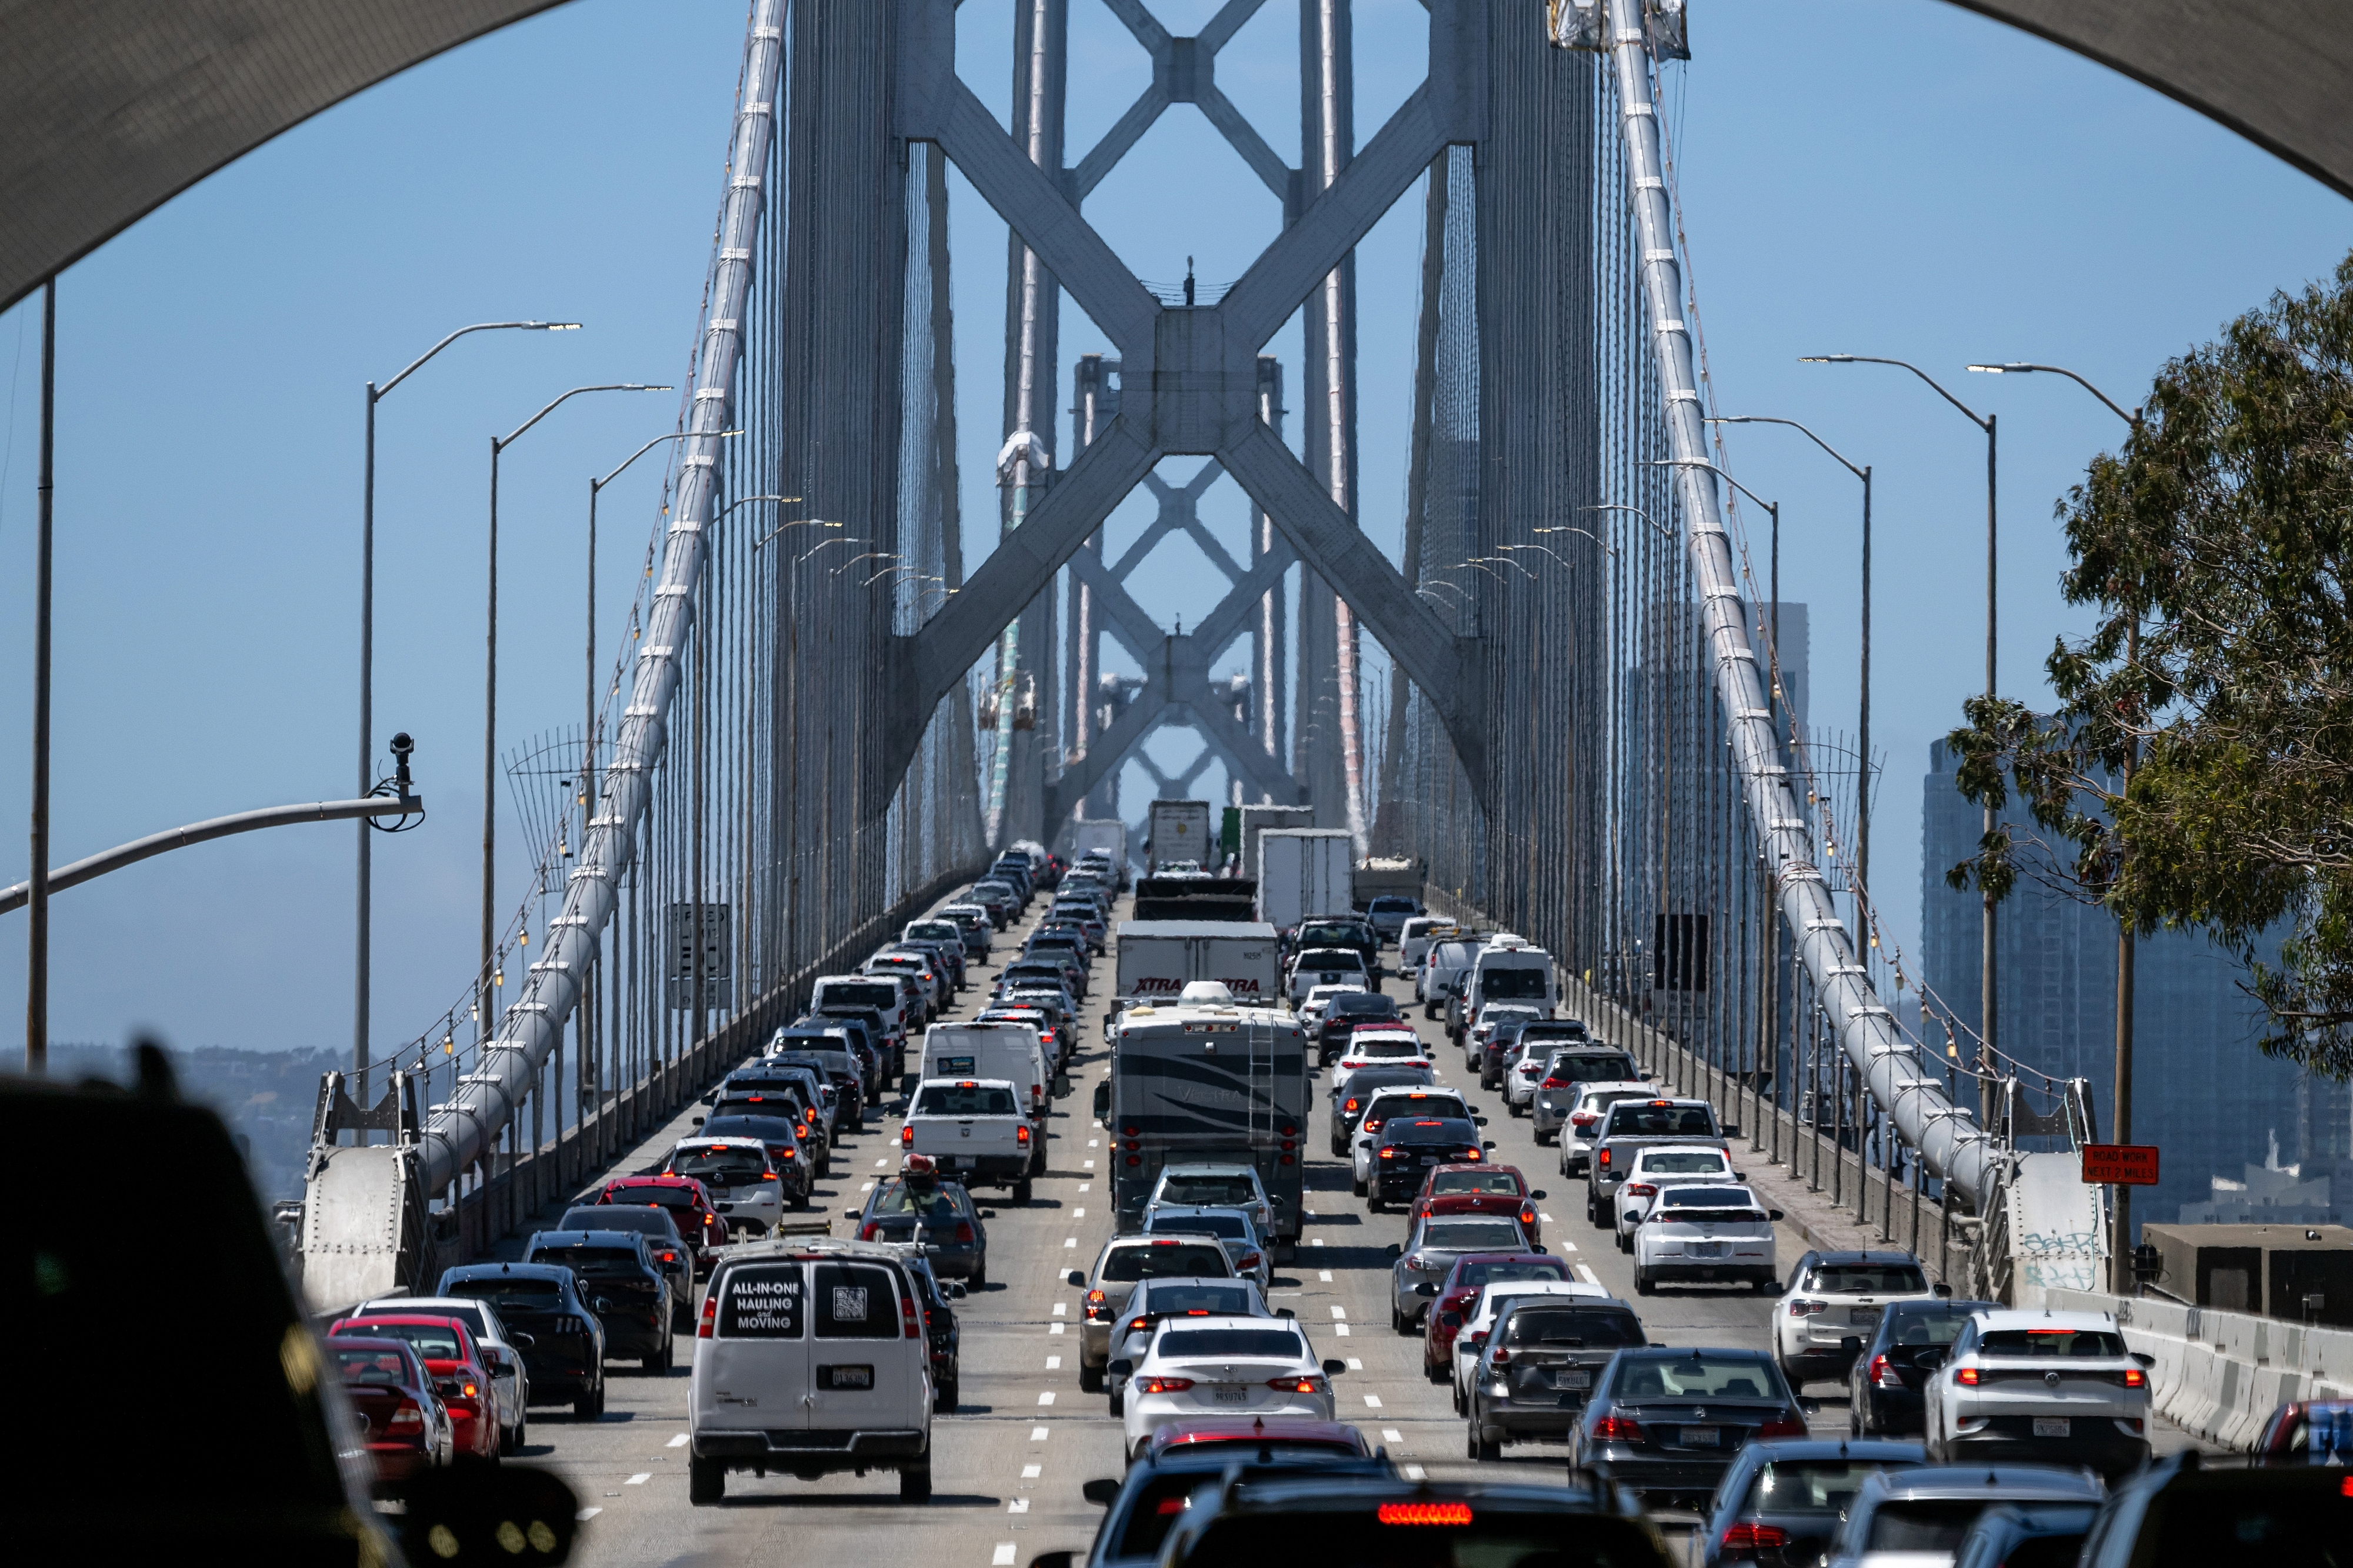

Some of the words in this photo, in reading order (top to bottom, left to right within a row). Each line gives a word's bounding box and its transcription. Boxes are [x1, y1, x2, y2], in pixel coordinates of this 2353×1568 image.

[1131, 977, 1182, 995] XTRA
[2093, 1151, 2118, 1162] ROAD
[2122, 1152, 2148, 1163] WORK
[2087, 1166, 2111, 1177] NEXT
[2115, 1167, 2121, 1178] 2
[2124, 1167, 2154, 1179] MILES
[732, 1282, 799, 1295] ALL-IN-ONE
[737, 1297, 792, 1311] HAULING
[757, 1309, 772, 1318] and
[738, 1317, 791, 1329] MOVING
